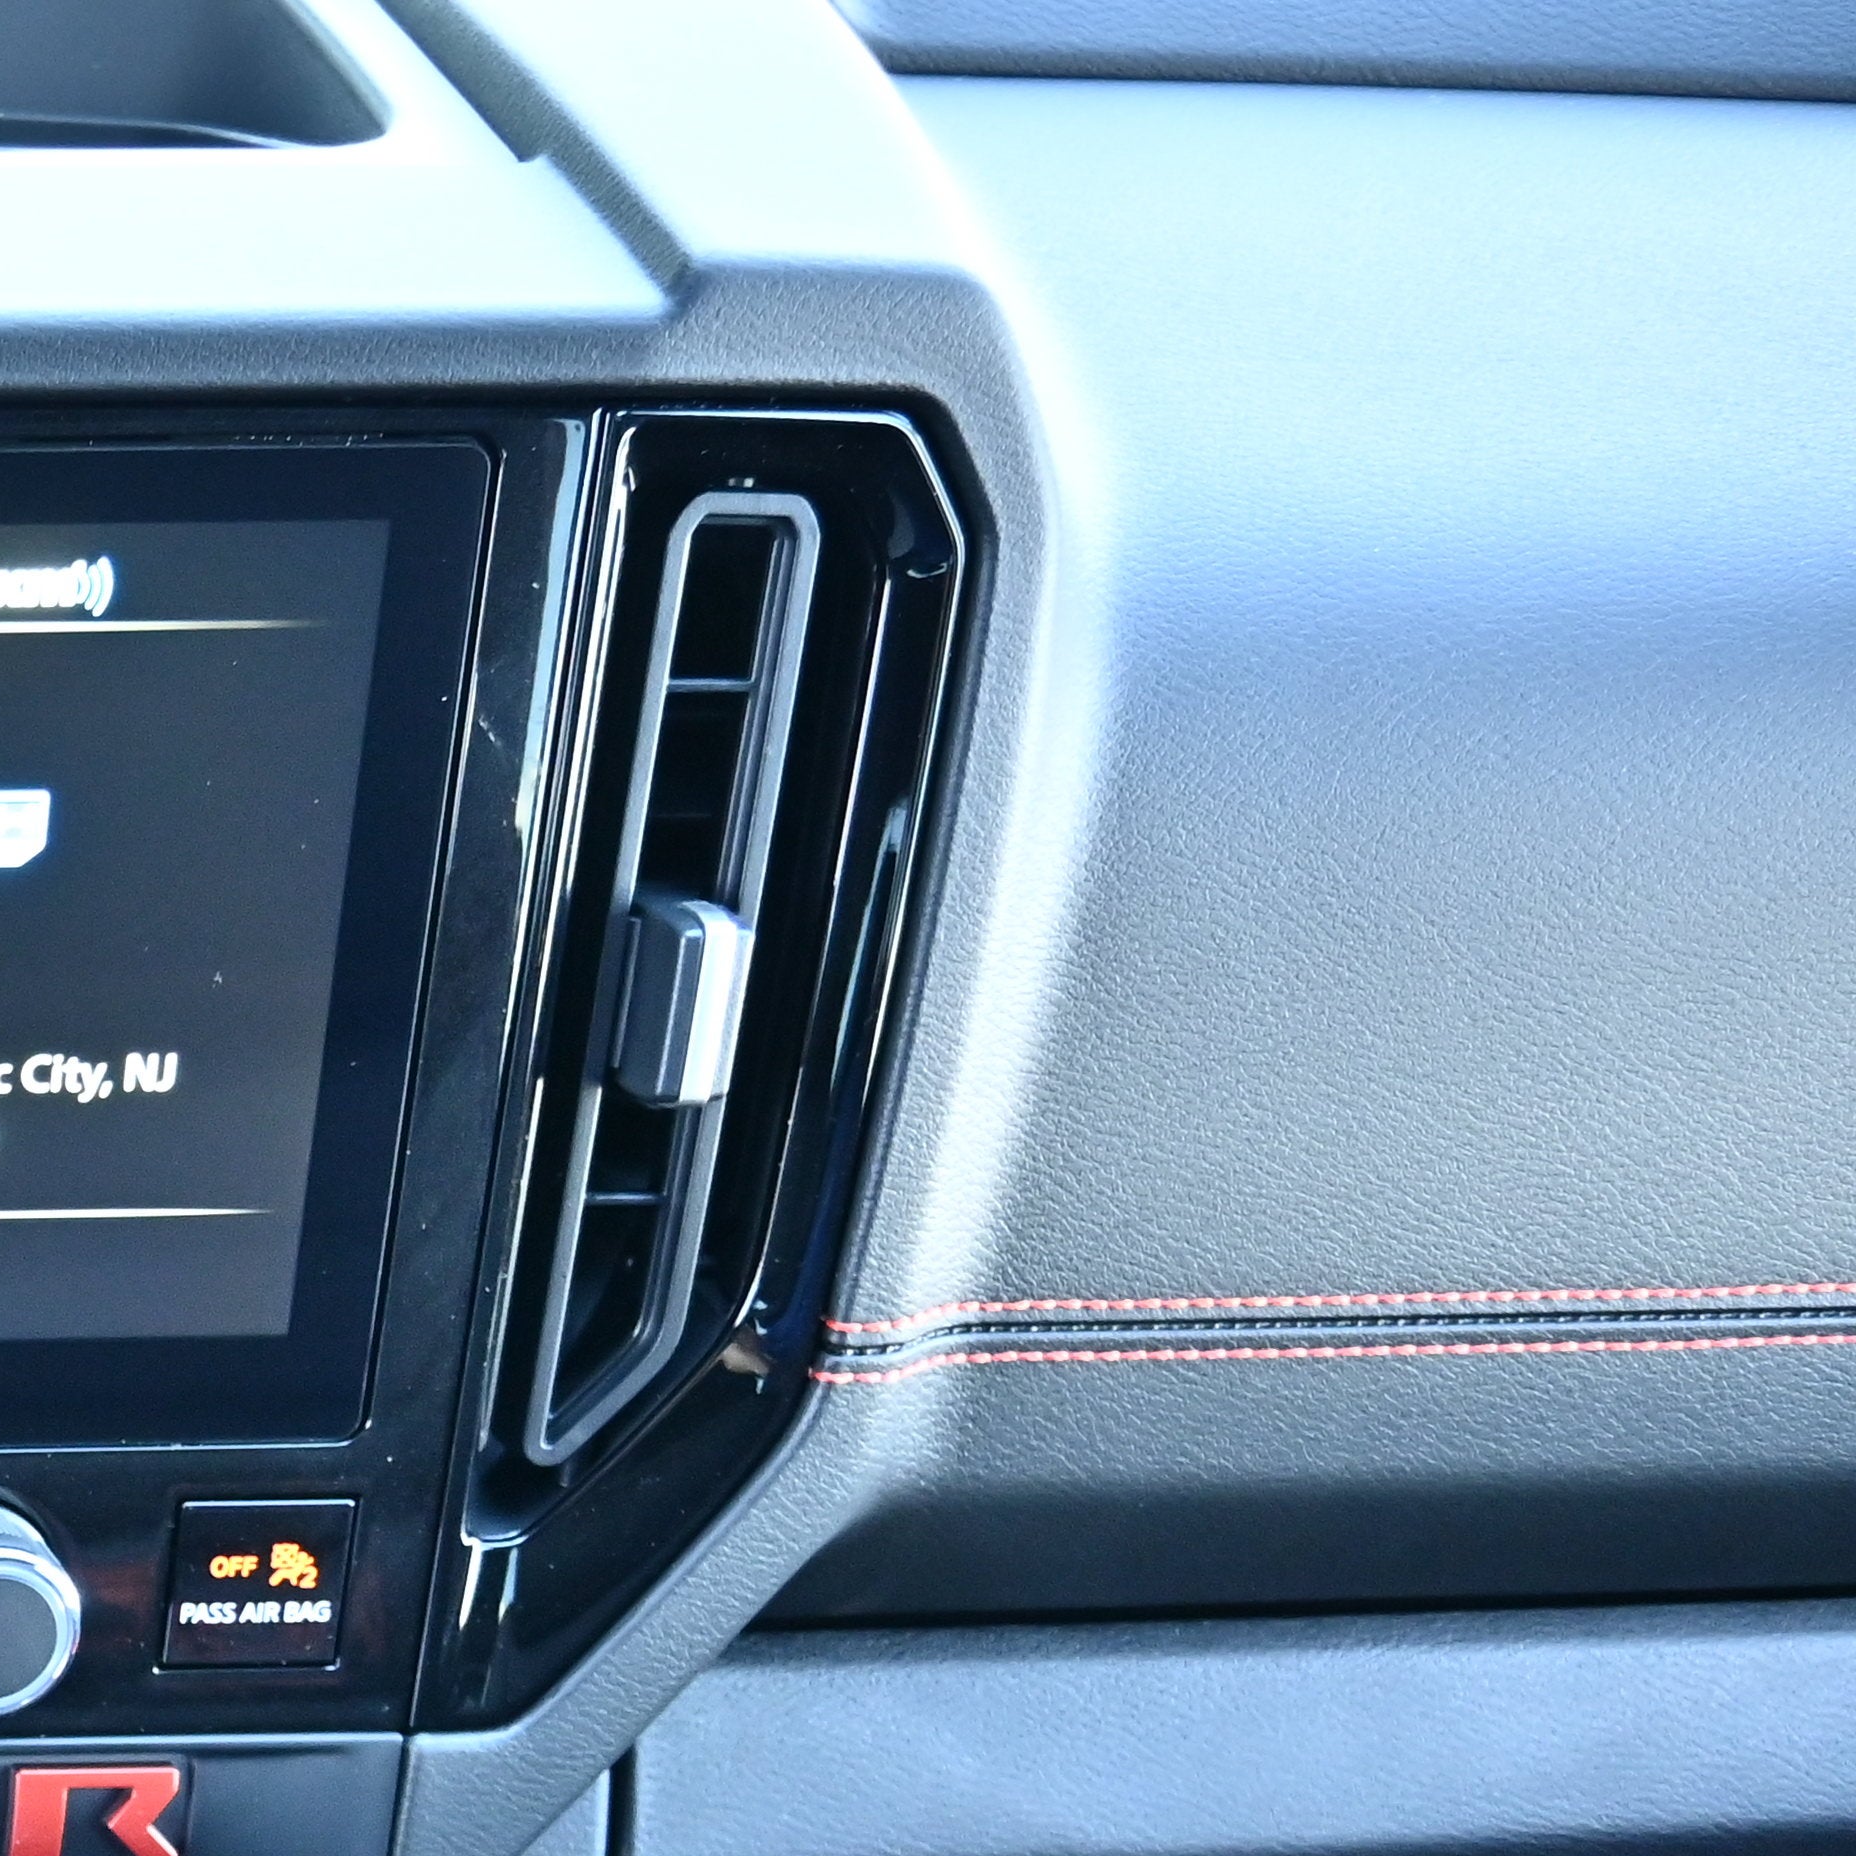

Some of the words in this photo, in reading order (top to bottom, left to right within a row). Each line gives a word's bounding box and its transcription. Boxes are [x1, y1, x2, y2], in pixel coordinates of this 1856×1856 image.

[19, 1053, 111, 1103] City,
[122, 1051, 179, 1093] NJ
[209, 1555, 259, 1578] OFF
[179, 1602, 237, 1624] PASS
[238, 1601, 281, 1624] AIR
[283, 1600, 332, 1623] BAG
